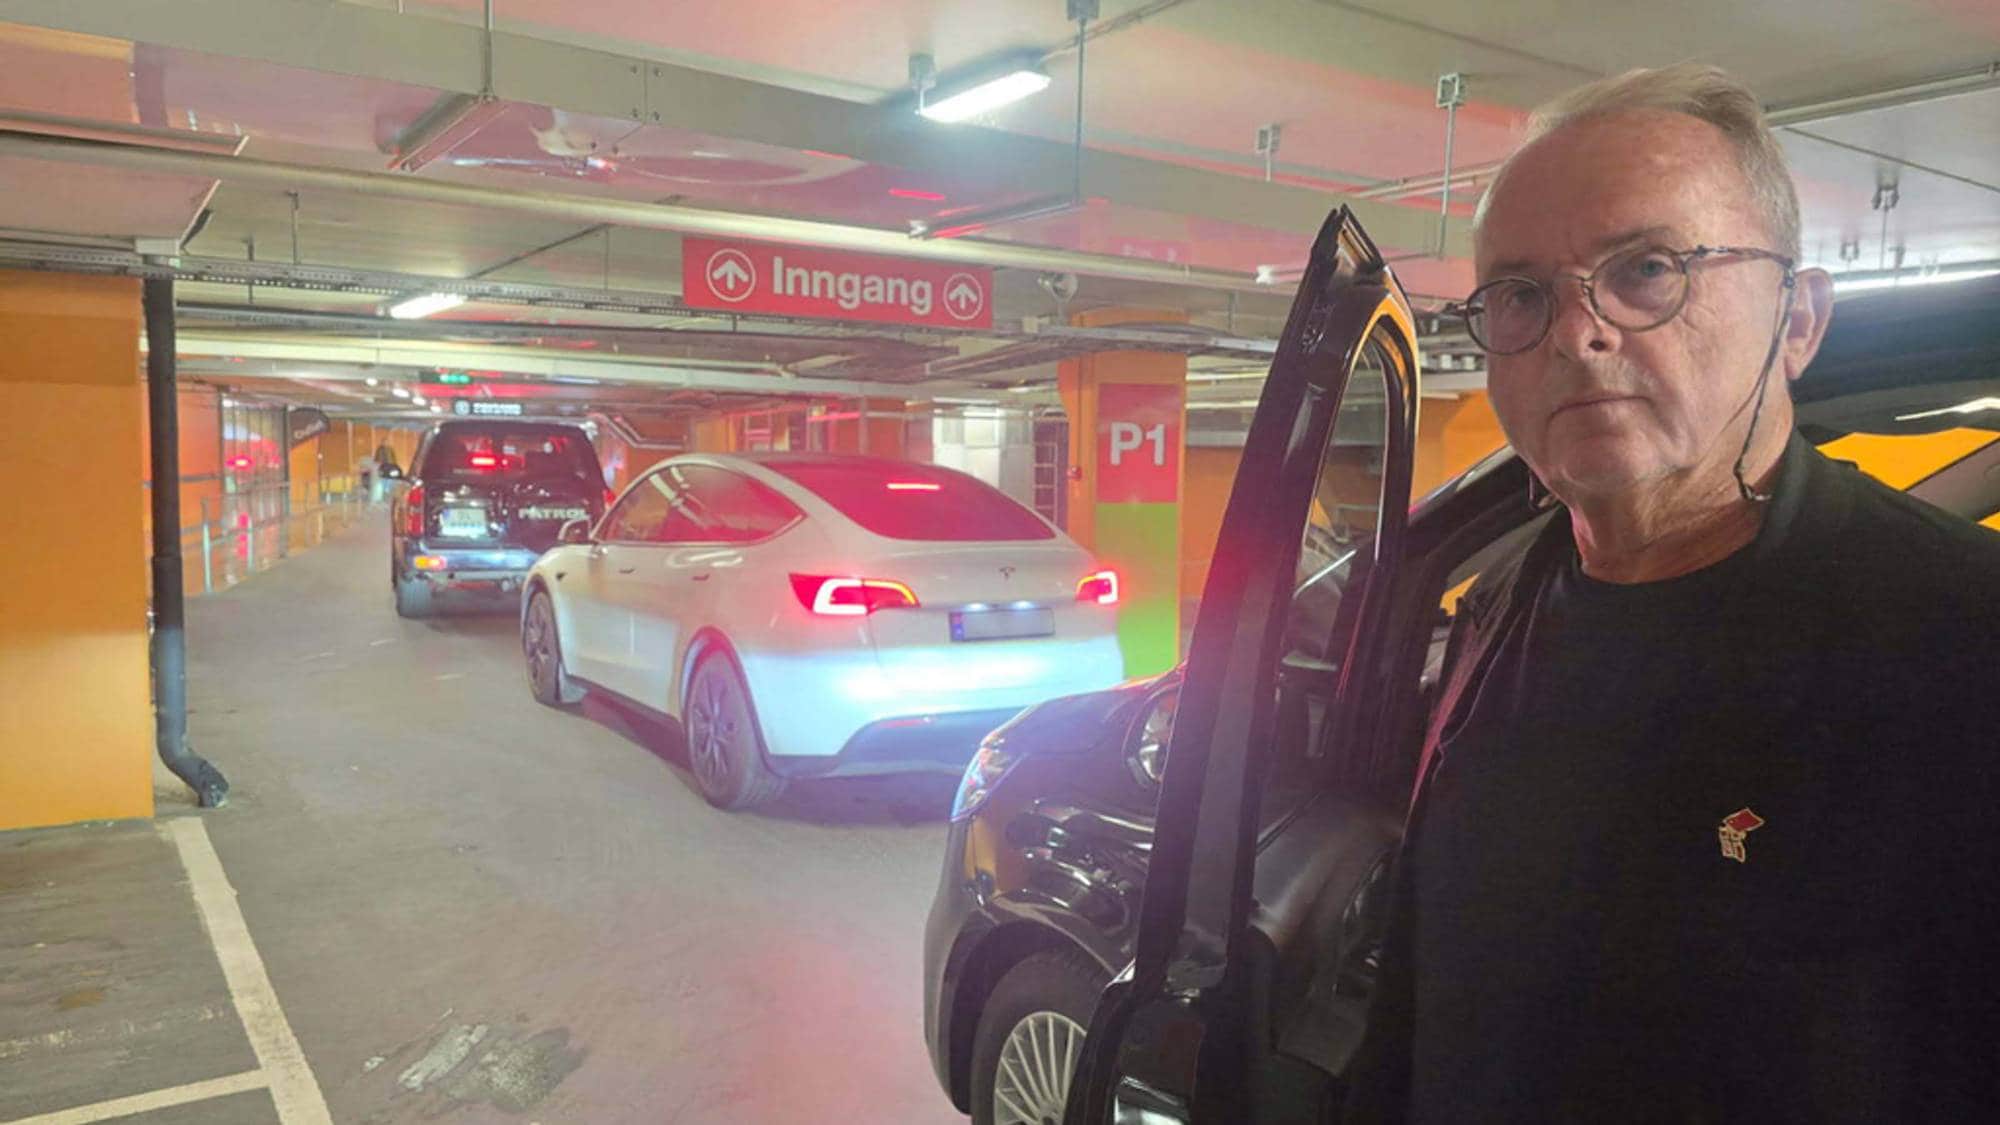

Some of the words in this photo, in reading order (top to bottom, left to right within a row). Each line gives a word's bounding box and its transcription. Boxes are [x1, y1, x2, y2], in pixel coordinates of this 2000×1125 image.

[772, 256, 932, 316] Inngang
[1110, 421, 1165, 466] P1
[518, 505, 590, 520] PATROL
